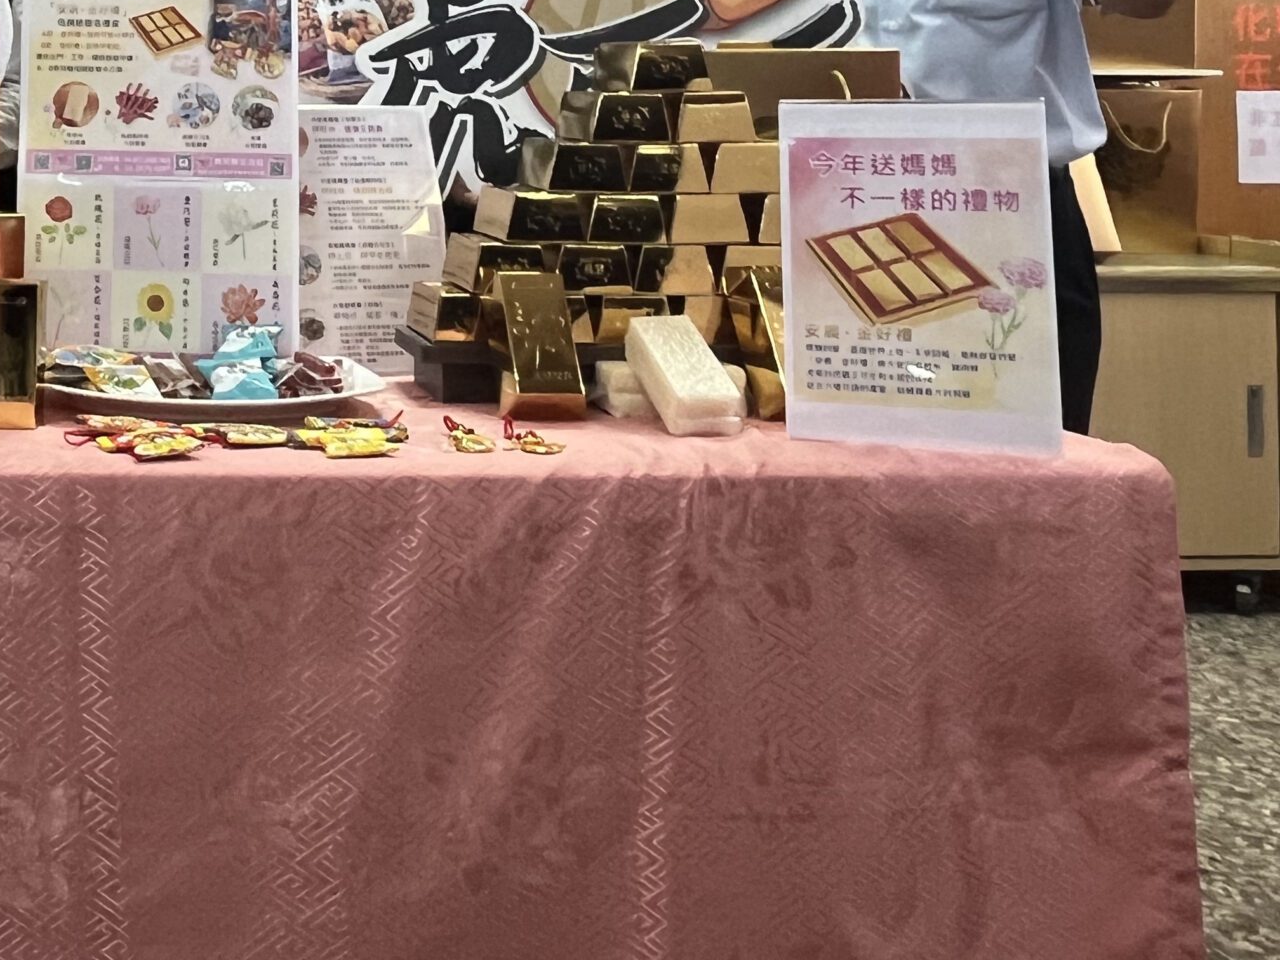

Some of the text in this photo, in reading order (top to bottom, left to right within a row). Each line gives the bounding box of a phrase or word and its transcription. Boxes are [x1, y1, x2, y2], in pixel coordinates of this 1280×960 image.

[1233, 3, 1280, 42] 化
[810, 151, 958, 177] 今年送媽媽
[839, 186, 1021, 213] 不一樣的禮物
